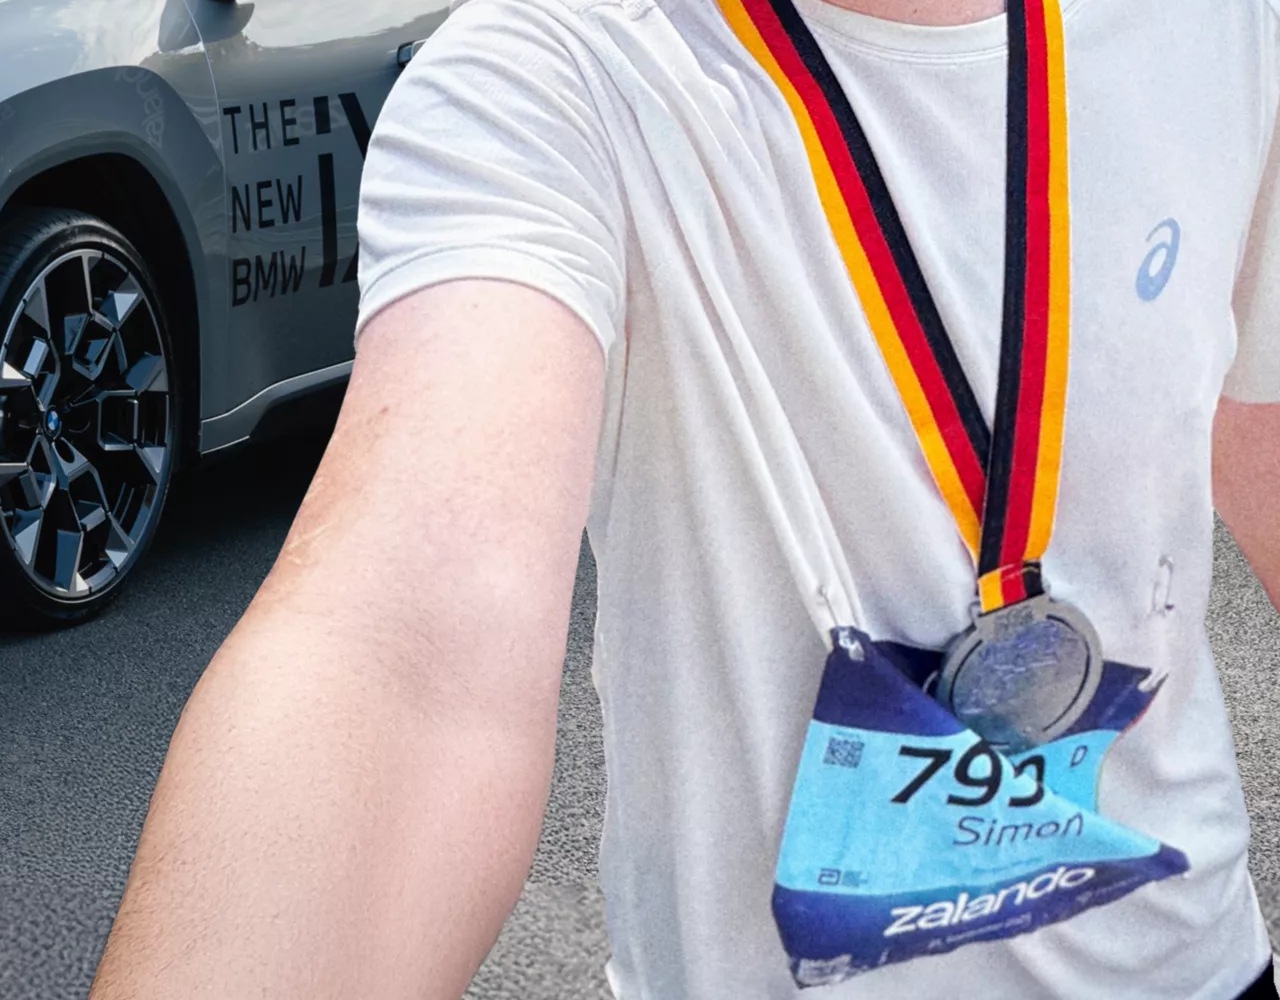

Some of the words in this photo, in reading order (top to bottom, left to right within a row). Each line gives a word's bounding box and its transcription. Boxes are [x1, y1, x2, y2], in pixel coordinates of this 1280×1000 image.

[222, 98, 300, 154] THE
[231, 175, 303, 233] NEW
[232, 246, 306, 307] BMW
[953, 811, 1084, 847] Simon
[884, 866, 1096, 936] zalando
